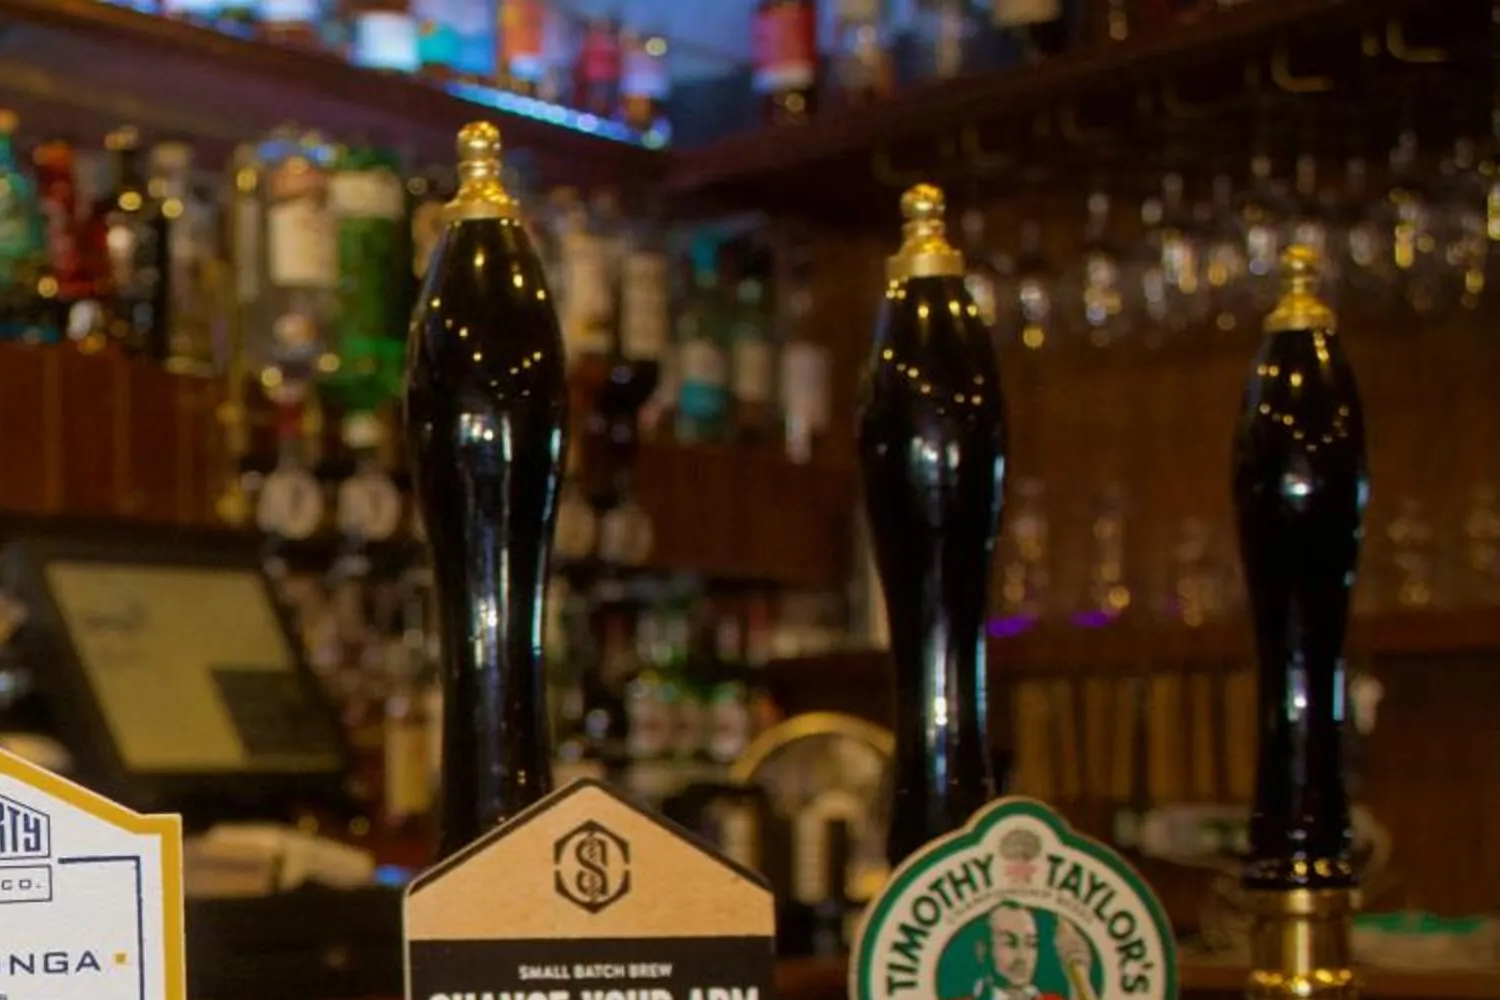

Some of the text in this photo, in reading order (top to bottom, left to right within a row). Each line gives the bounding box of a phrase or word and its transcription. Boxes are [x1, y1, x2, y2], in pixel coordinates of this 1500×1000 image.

[886, 853, 1155, 997] TIMOTHY TAYLOR'S
[519, 963, 673, 980] SMALL BATCH BREW
